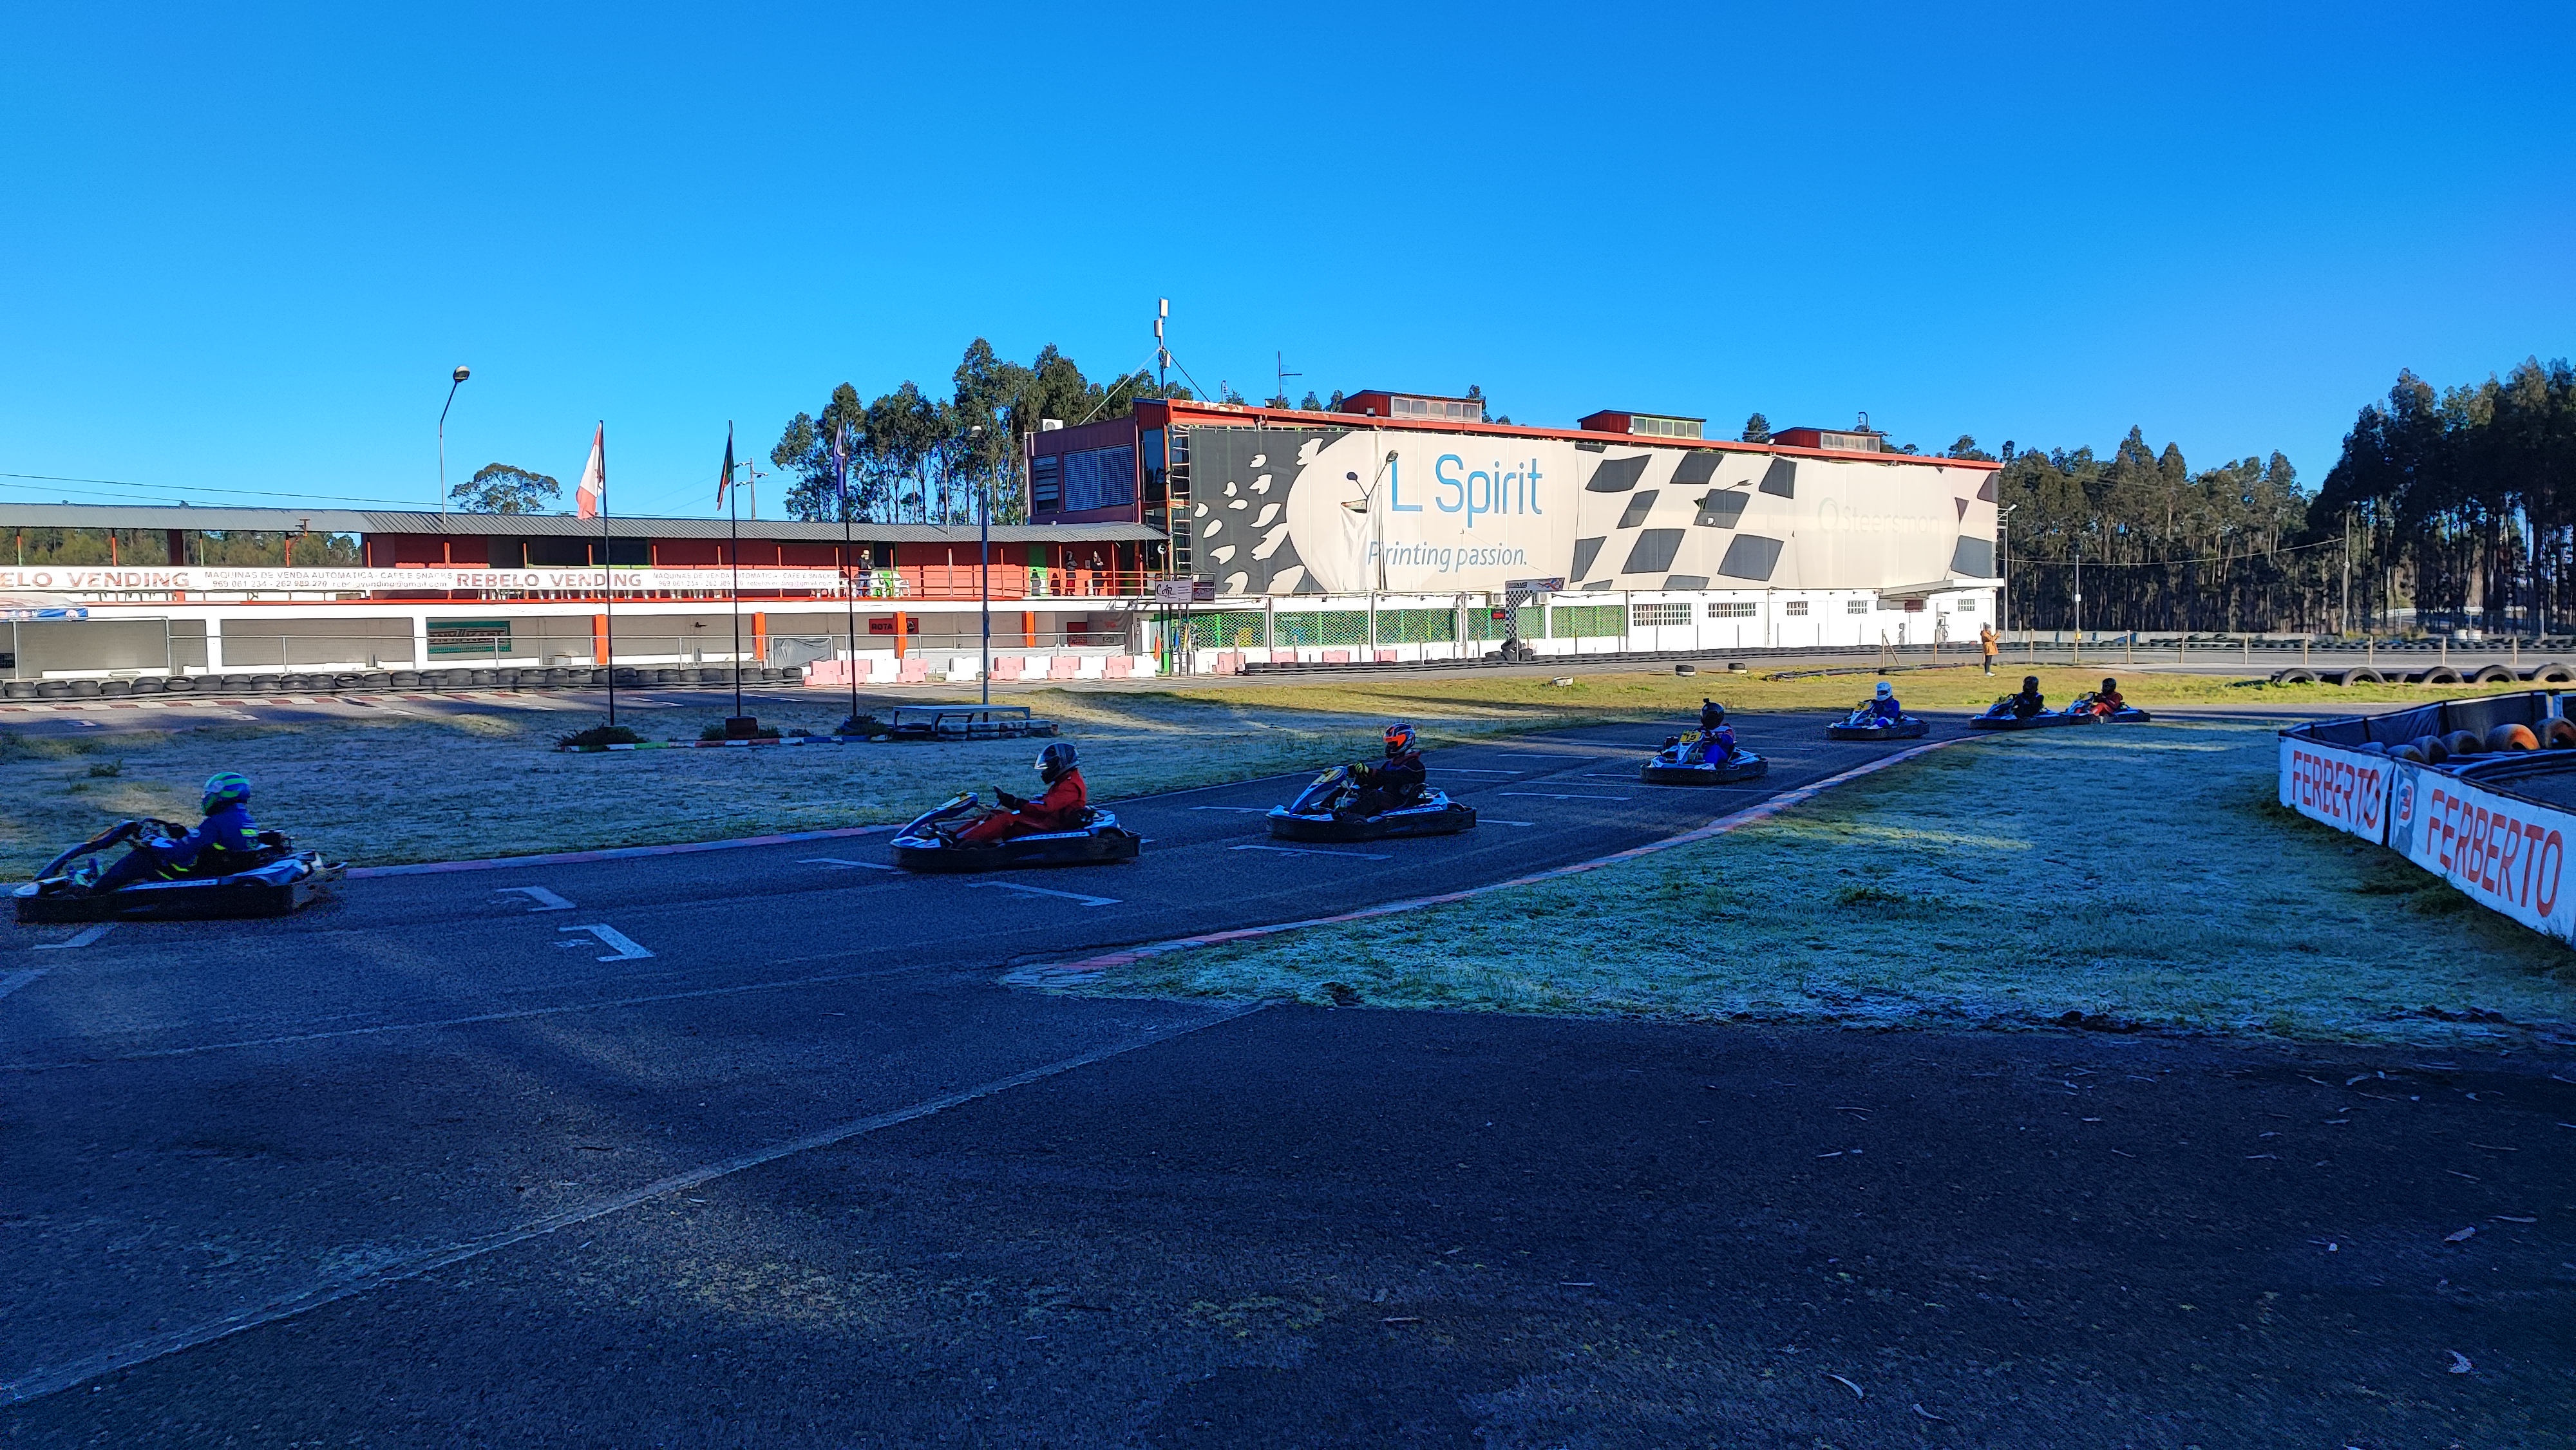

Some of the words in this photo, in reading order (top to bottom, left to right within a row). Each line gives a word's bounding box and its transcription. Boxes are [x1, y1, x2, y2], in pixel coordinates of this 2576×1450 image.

[1392, 456, 1423, 511] L
[1435, 454, 1542, 528] Spirit
[66, 572, 189, 587] VENDING
[457, 574, 539, 587] REBELO
[1368, 541, 1451, 572] Printing
[1455, 542, 1527, 573] passion.
[2293, 750, 2381, 829] FERBERTO
[2427, 789, 2562, 918] FERBERTO
